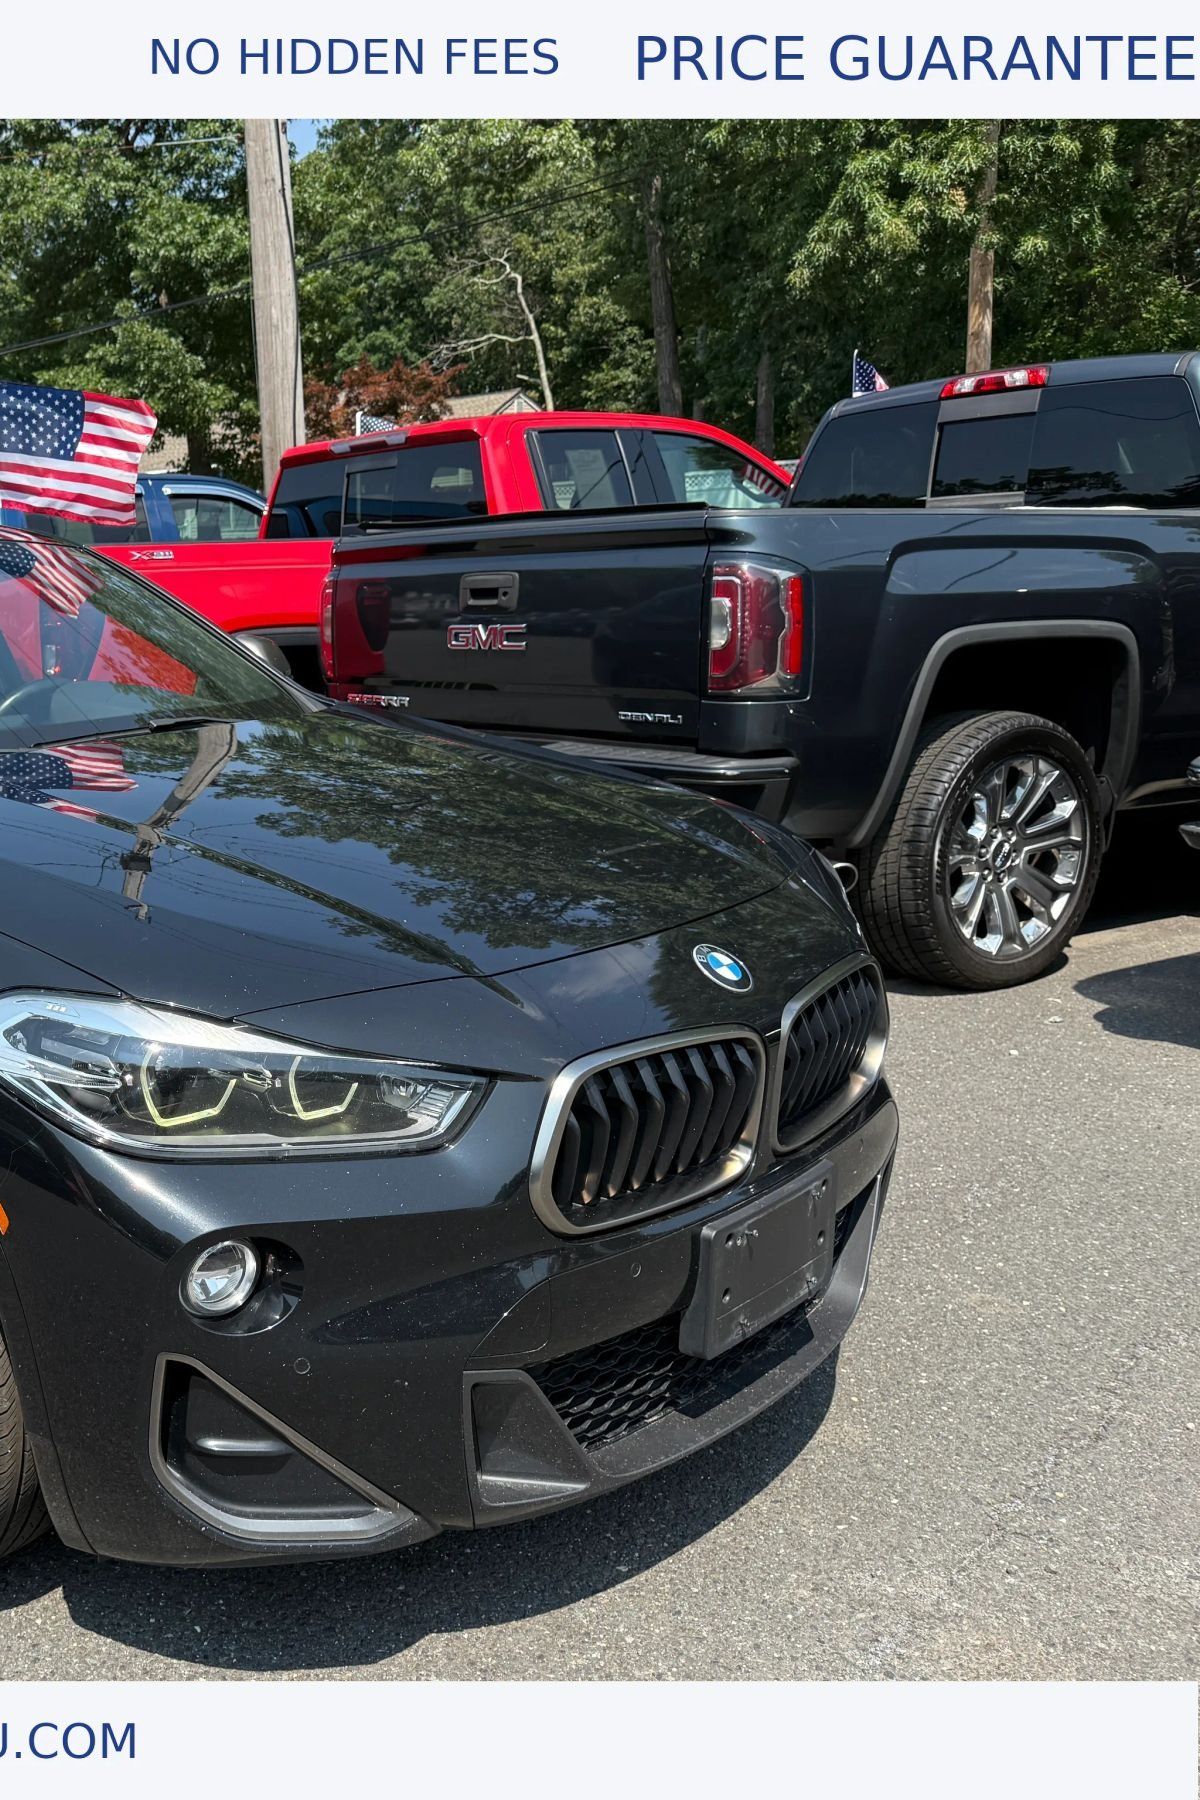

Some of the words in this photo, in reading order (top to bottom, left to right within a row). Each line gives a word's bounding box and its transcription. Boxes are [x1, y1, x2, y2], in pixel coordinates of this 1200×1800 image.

[447, 623, 528, 650] GMC
[347, 693, 410, 708] SIERRA
[618, 711, 683, 725] DENALI
